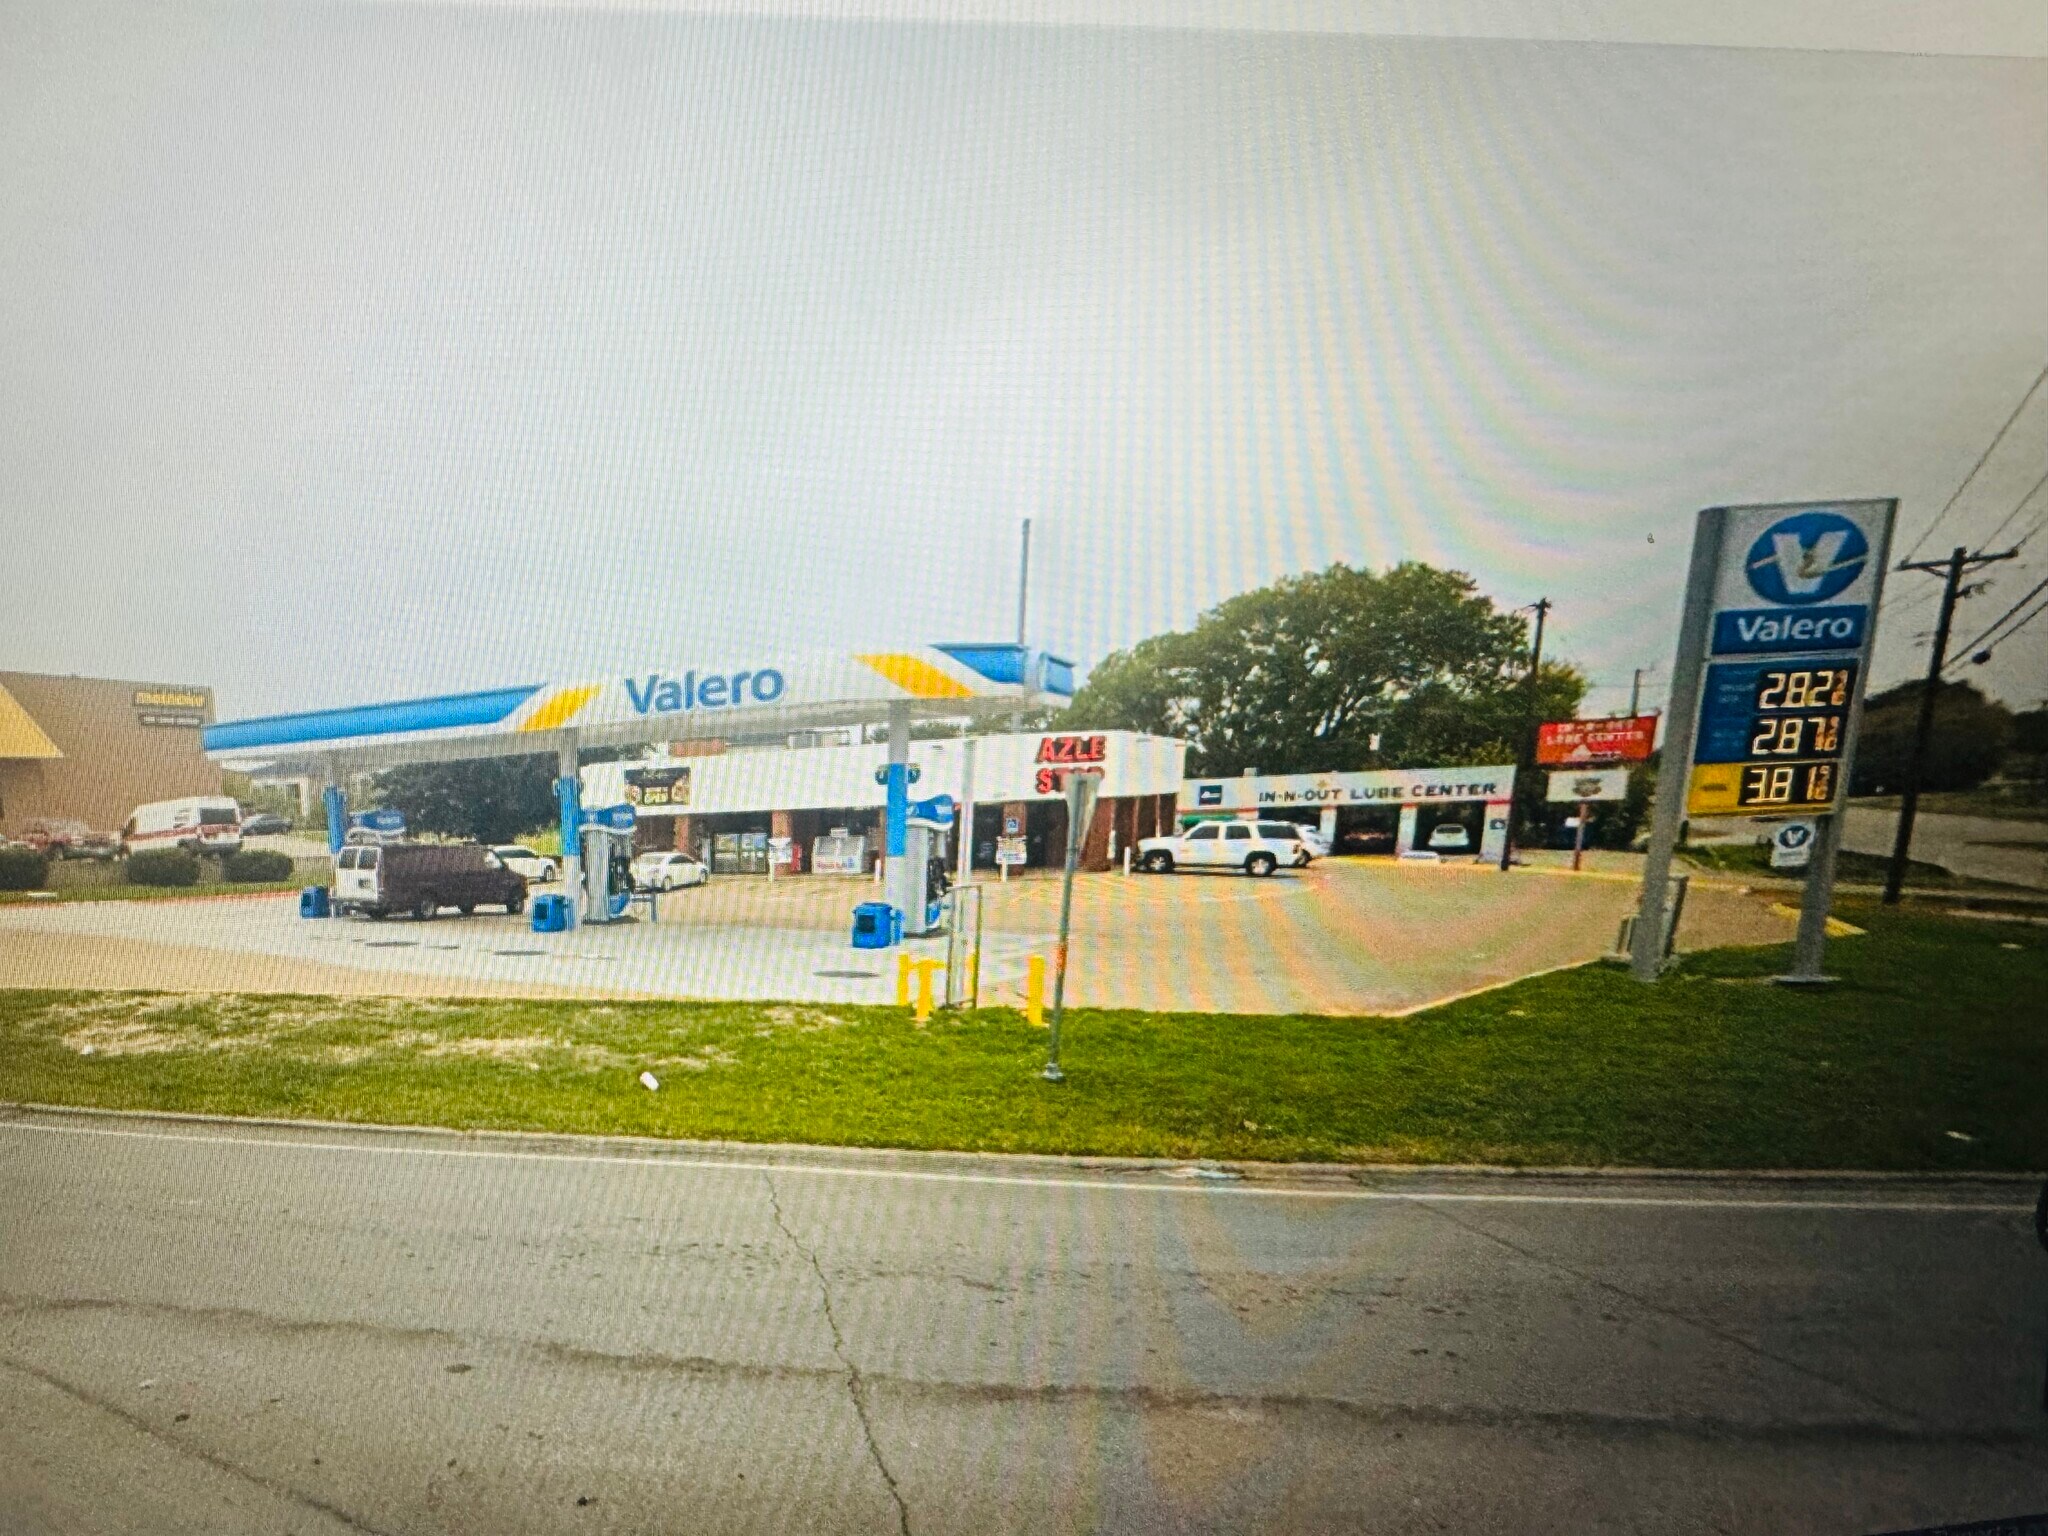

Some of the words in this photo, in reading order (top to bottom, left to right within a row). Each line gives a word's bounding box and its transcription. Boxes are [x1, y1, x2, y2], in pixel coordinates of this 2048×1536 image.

[1737, 614, 1853, 642] Valero
[626, 668, 784, 714] Valero
[1035, 735, 1106, 764] AZLE
[1035, 766, 1106, 794] ST
[1350, 786, 1404, 800] LUBE
[1412, 783, 1497, 797] CENTER
